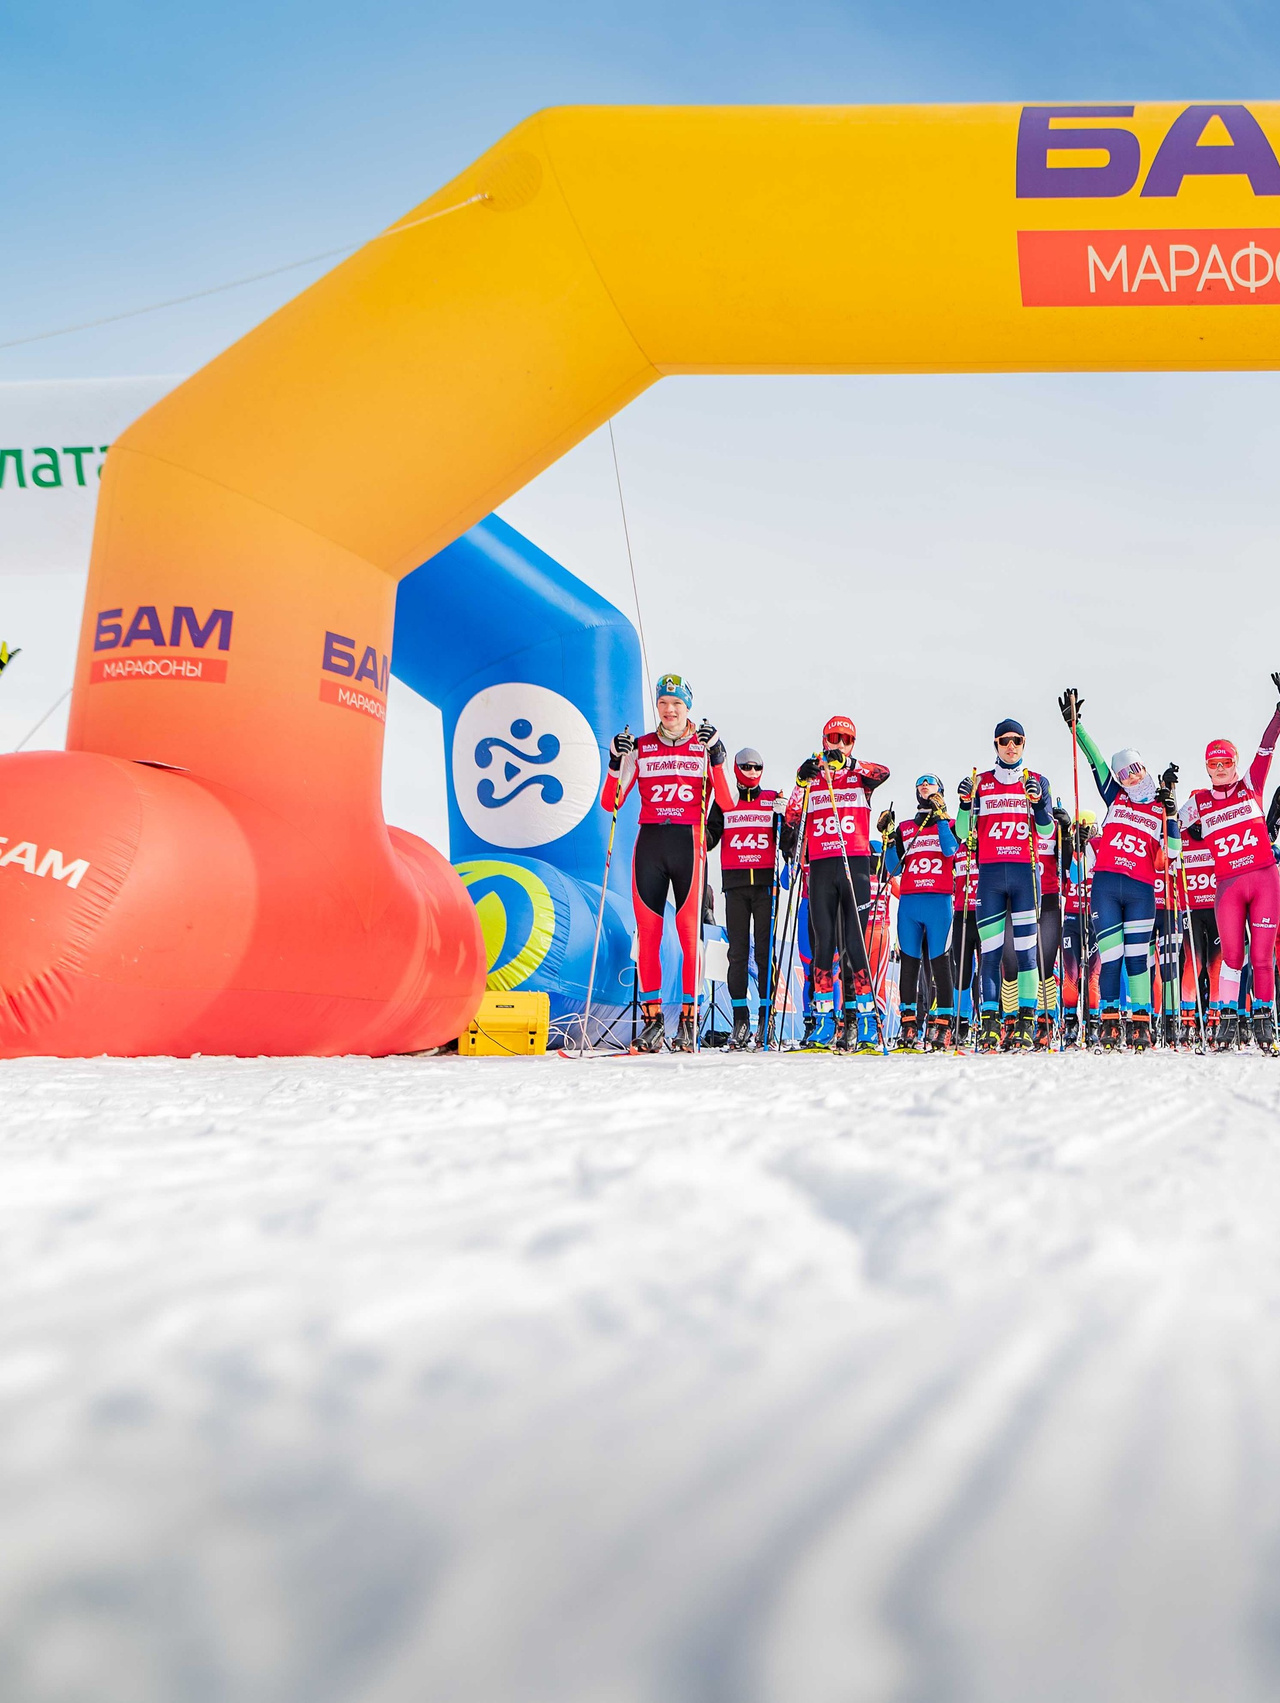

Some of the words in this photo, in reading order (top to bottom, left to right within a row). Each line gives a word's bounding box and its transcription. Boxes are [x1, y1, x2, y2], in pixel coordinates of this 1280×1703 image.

[0, 446, 107, 488] лат
[94, 606, 233, 652] БАМ
[103, 659, 202, 678] МАРАФОНЫ
[338, 688, 385, 721] МАРАФОН
[828, 720, 854, 732] LUKOIL
[647, 760, 699, 772] ТЕМЕРСО
[651, 784, 694, 802] 276
[813, 816, 856, 837] 386
[1114, 809, 1157, 830] ТЕМЕРСО
[1205, 804, 1252, 828] ТЕМЕРСО
[988, 821, 1029, 840] 479
[730, 833, 769, 850] 445
[1109, 832, 1147, 857] 453
[1214, 829, 1259, 857] 324
[0, 836, 91, 889] АМ
[908, 858, 943, 875] 492
